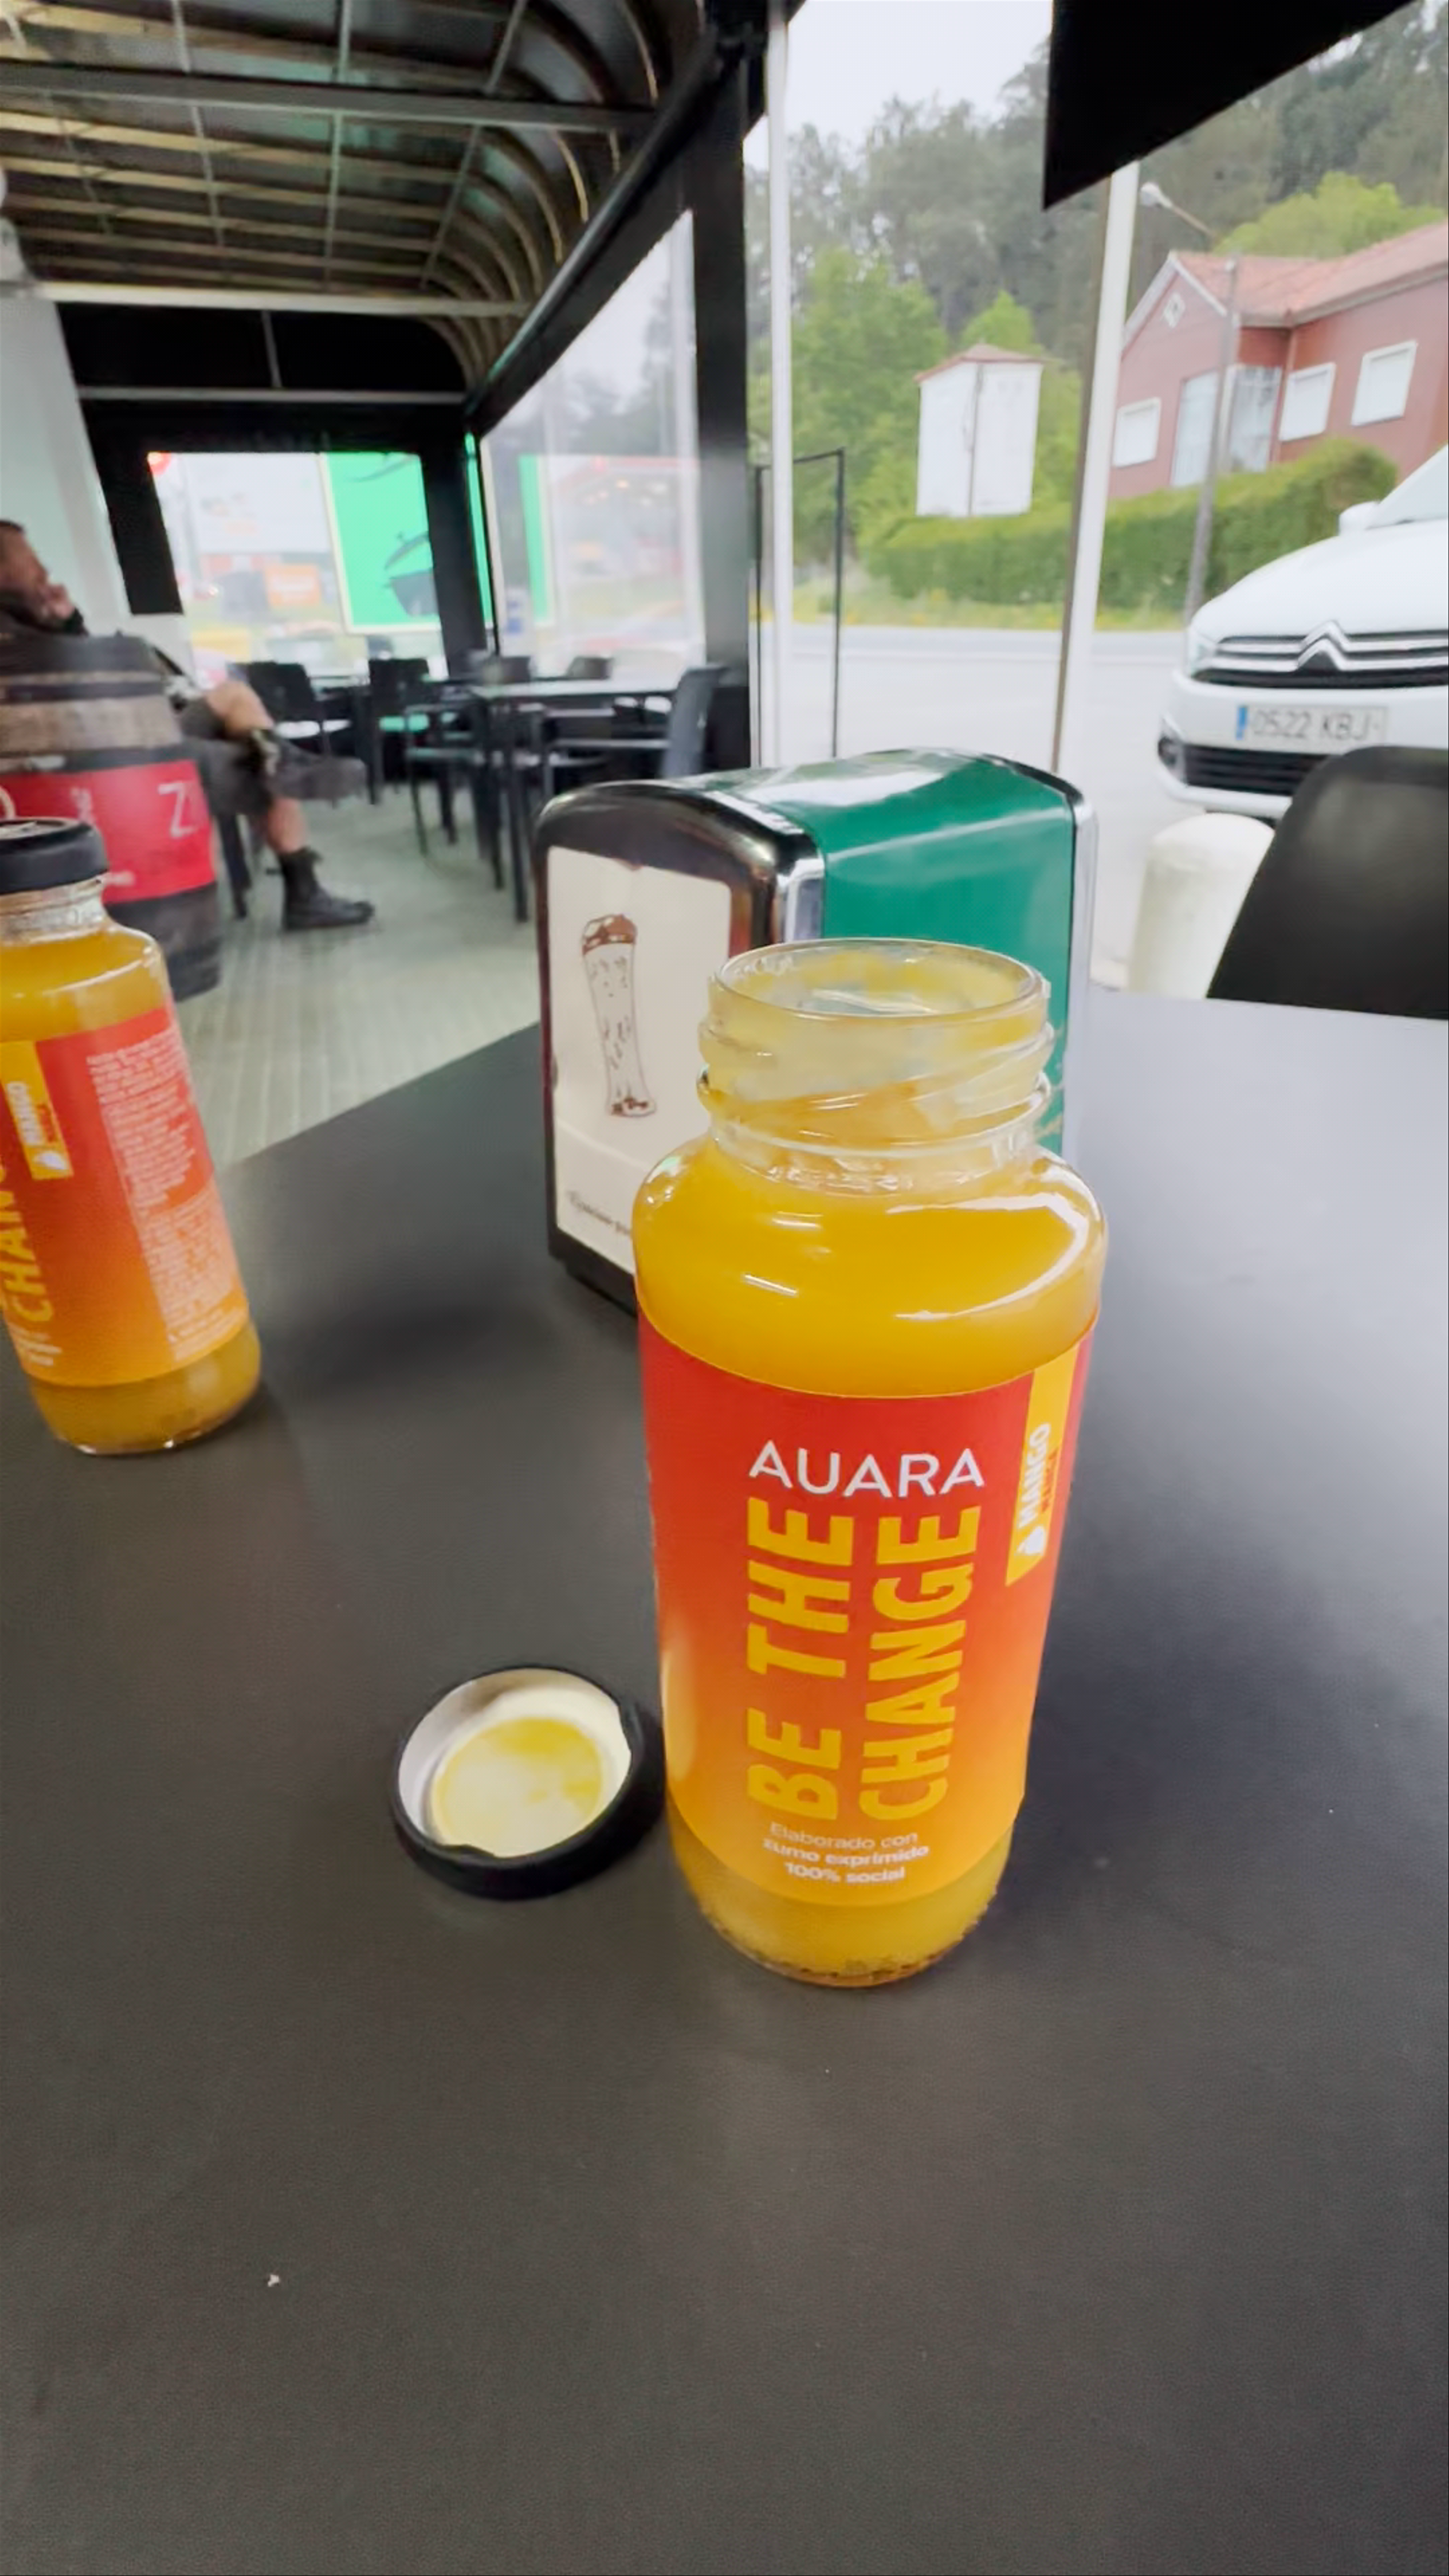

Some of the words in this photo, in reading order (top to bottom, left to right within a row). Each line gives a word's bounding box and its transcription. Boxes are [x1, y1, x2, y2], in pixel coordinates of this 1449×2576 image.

[748, 1439, 984, 1498] AUARA
[746, 1497, 855, 1678] THE
[858, 1506, 981, 1821] CHANGE
[746, 1707, 841, 1820] BE
[770, 1822, 876, 1849] Elaborado
[880, 1833, 918, 1848] con
[825, 1846, 930, 1868] exprimido
[785, 1862, 840, 1883] 100%
[846, 1867, 906, 1884] social
